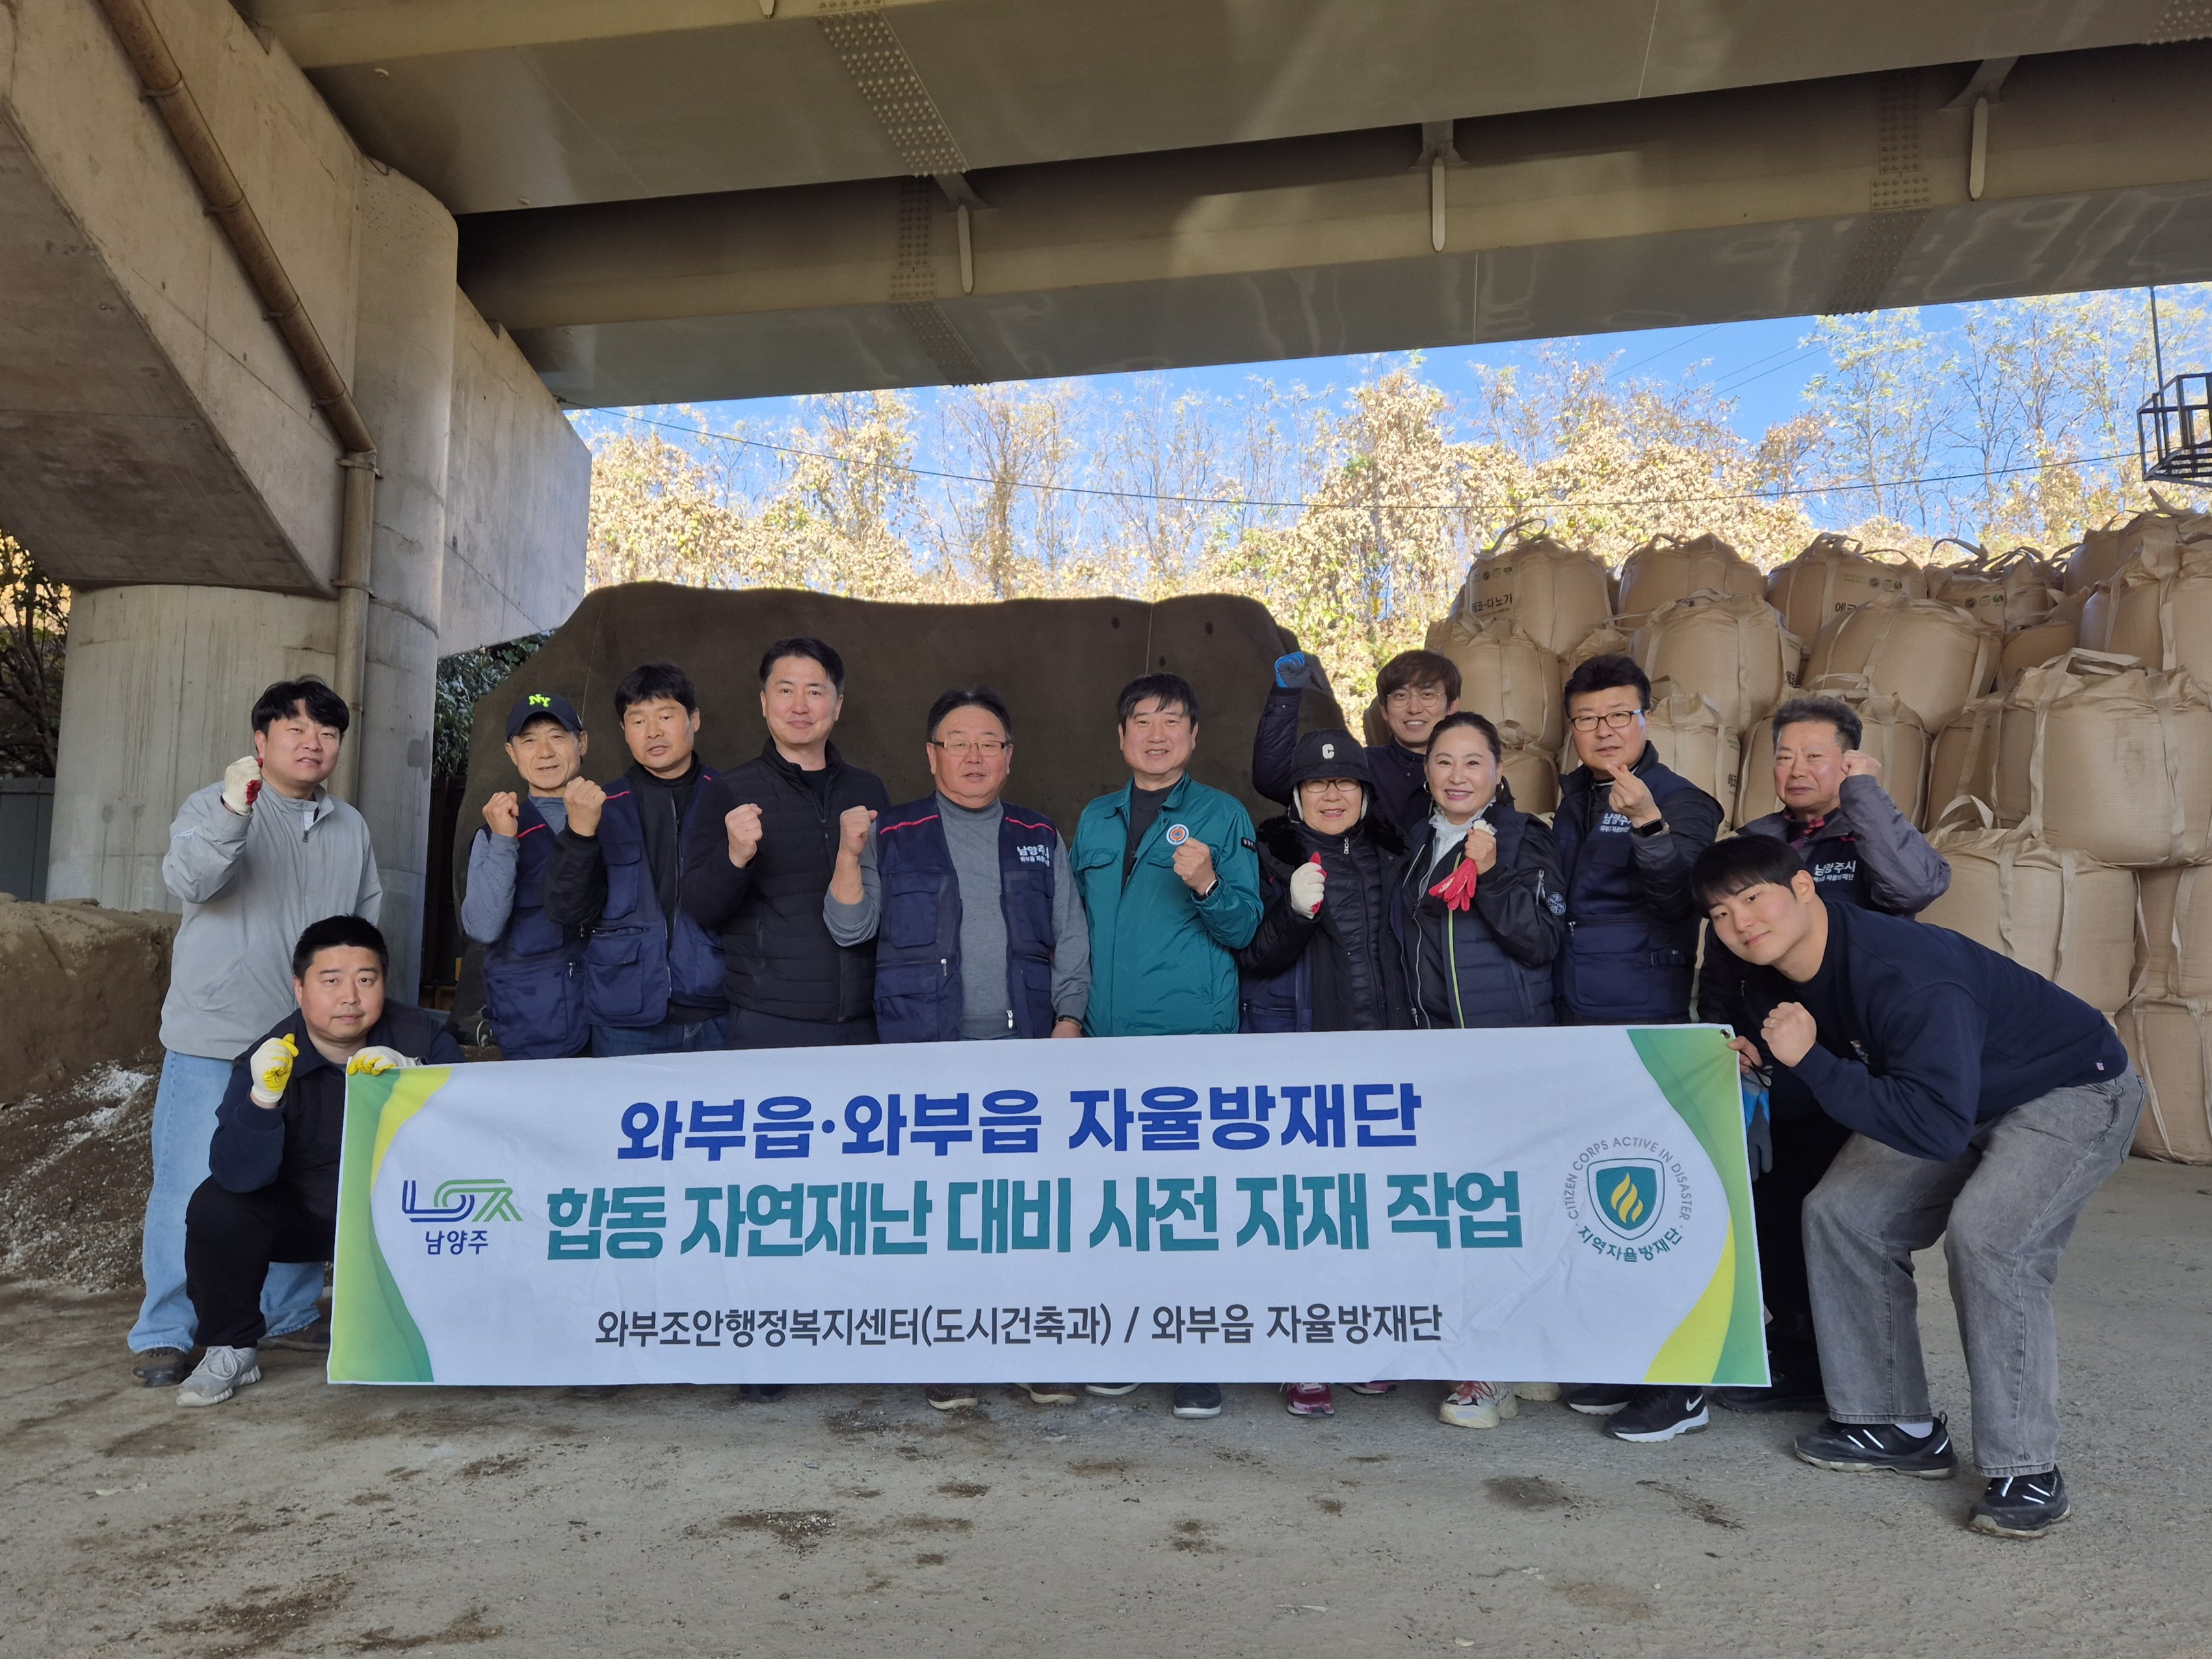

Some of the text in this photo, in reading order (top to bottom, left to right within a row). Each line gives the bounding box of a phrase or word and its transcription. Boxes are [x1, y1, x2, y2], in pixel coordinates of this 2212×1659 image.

[529, 694, 551, 708] NY
[1322, 743, 1335, 759] C
[1603, 813, 1632, 826] 남양주
[1814, 859, 1856, 876] 남양주시
[617, 1083, 1423, 1162] 와부읍·와부읍 자율방재단
[1564, 1136, 1692, 1221] CITIZEN CORPS ACTIVE IN DISASTER
[547, 1171, 1523, 1261] 합동 자연재난 대비 사전 자재 작업
[425, 1230, 488, 1255] 남양주
[1577, 1225, 1683, 1262] 지역자율방재단
[595, 1303, 1443, 1348] 와부조안행정복지센터(도시건축과) / 와부읍 자율방재단
